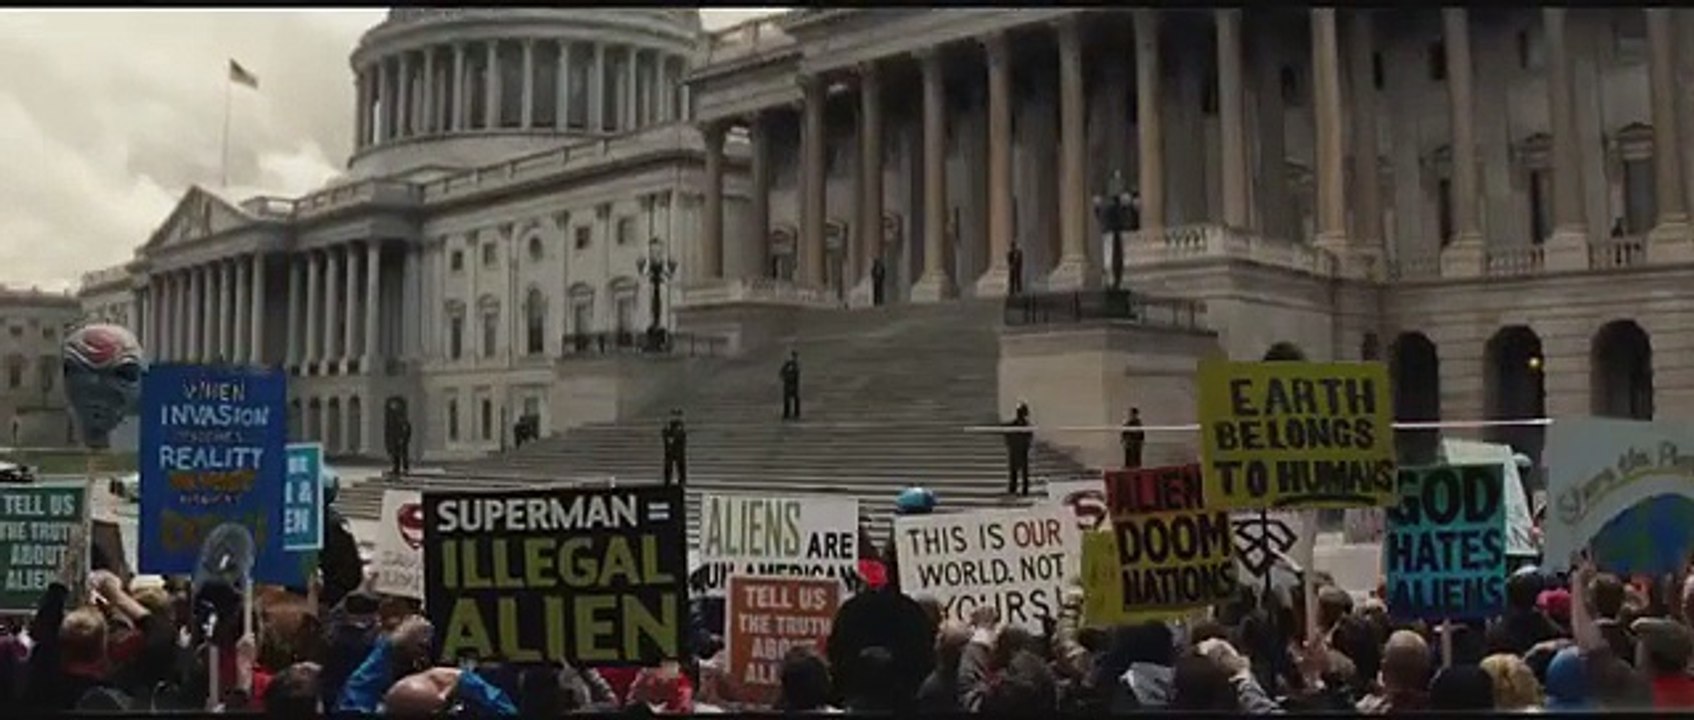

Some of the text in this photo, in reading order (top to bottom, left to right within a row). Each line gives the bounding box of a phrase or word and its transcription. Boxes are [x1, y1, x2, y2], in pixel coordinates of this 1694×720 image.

[1229, 378, 1375, 415] EARTH
[160, 405, 270, 427] INVASION
[1214, 420, 1374, 450] BELONGS
[158, 445, 263, 470] REALITY
[1106, 466, 1204, 513] ALIEN
[1213, 461, 1269, 497] TO
[1392, 469, 1500, 525] GOD
[4, 494, 76, 515] TELL US
[437, 496, 637, 531] SUPERMAN
[648, 503, 669, 520] =
[706, 499, 853, 559] ALIENS ARE
[908, 519, 1063, 555] THIS IS OUR
[1115, 512, 1231, 566] DOOM
[11, 544, 68, 565] ABOUT
[442, 535, 674, 588] ILLEGAL
[1389, 529, 1502, 571] HATES
[918, 553, 1065, 589] WORLD. NOT
[1121, 565, 1236, 610] NATIONS
[744, 586, 827, 610] TELL US
[1388, 576, 1503, 613] ALIENS
[441, 594, 679, 662] ALIEN
[738, 613, 832, 635] THE TRUTH
